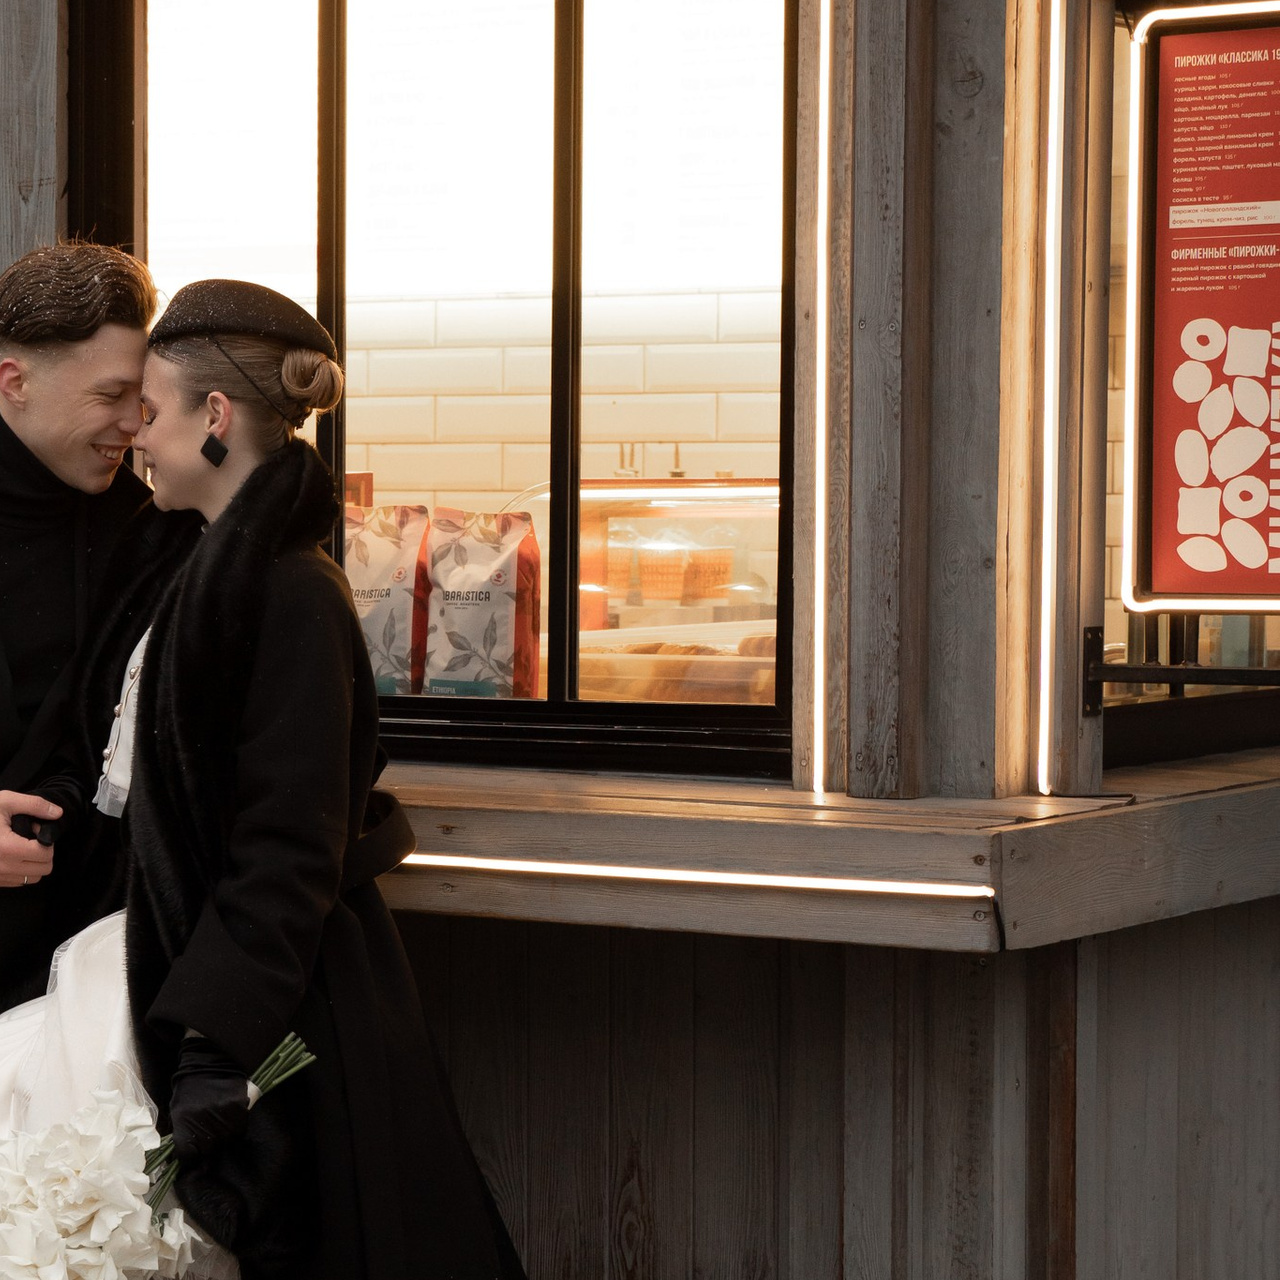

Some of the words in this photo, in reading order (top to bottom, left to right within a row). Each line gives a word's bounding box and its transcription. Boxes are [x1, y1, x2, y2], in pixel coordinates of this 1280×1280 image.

[1174, 54, 1217, 68] ПИРОЖКИ
[1218, 49, 1269, 64] «КЛАССИКА
[1174, 75, 1197, 83] лесные
[1238, 91, 1267, 99] демиглас
[1195, 144, 1223, 152] заварной
[1224, 142, 1257, 150] ванильный
[1246, 161, 1272, 169] луковый
[1171, 246, 1227, 260] ФИРМЕННЫЕ
[1171, 265, 1199, 273] жареный
[1233, 262, 1254, 270] рваной
[1233, 272, 1266, 280] картошкой
